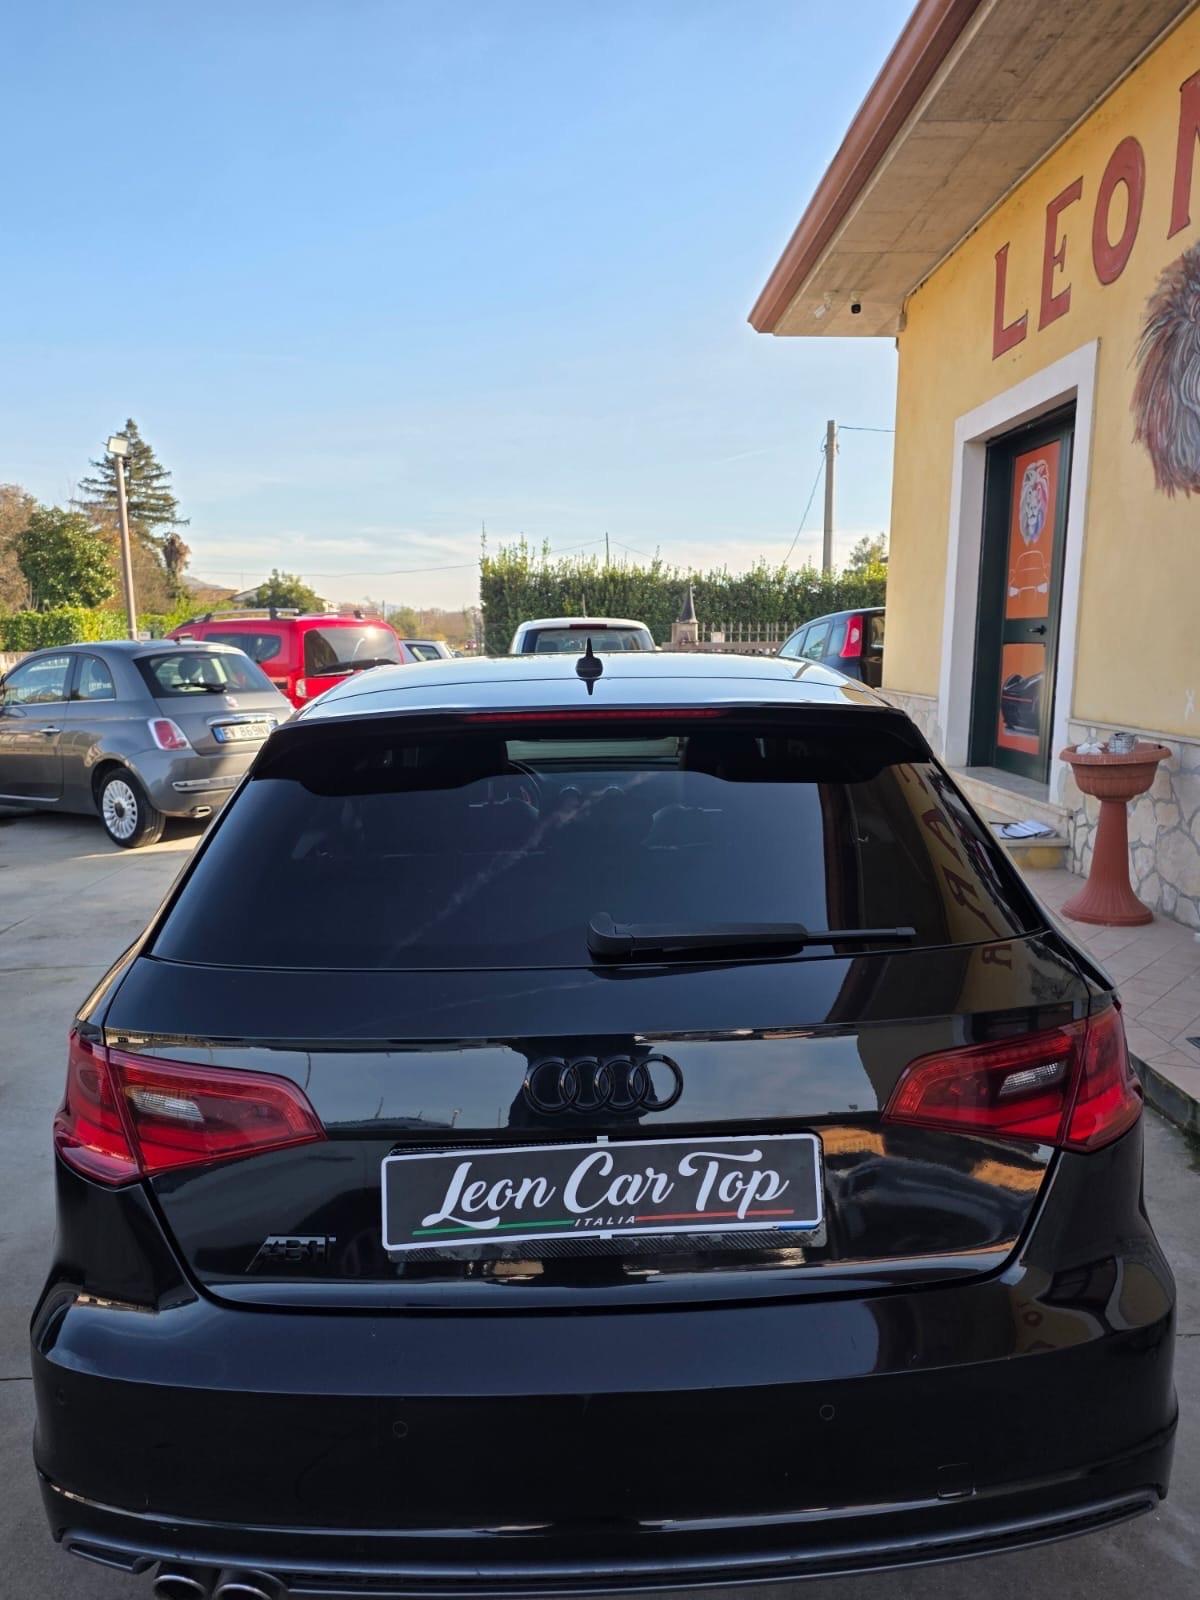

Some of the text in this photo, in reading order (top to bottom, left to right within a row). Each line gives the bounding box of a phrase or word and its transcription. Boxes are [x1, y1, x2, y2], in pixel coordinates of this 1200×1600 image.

[421, 1148, 790, 1230] Leon Car Top
[574, 1215, 636, 1227] ITALIA
